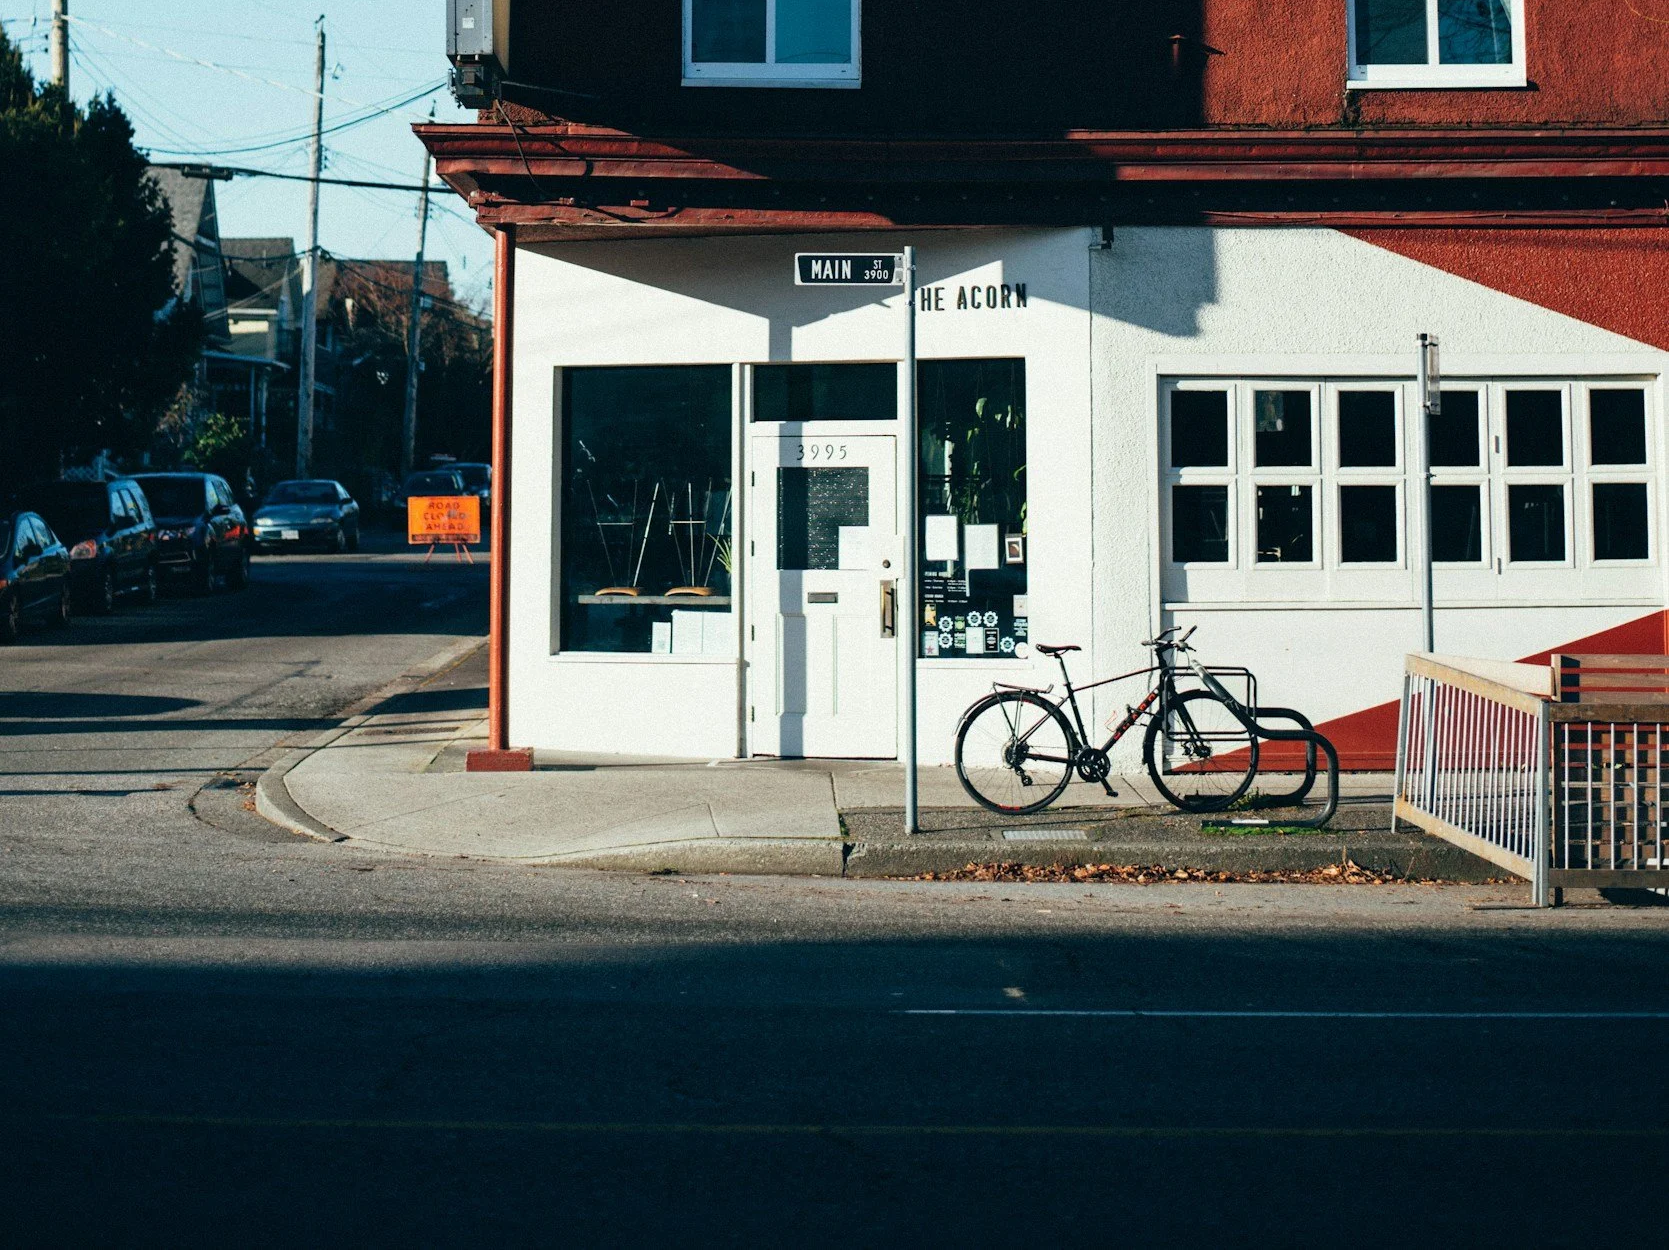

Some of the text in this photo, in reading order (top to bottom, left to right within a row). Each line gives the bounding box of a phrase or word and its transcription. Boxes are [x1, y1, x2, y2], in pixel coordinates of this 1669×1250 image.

[811, 259, 883, 279] MAIN ST
[864, 269, 889, 280] 3900
[917, 283, 1027, 312] HE ACORN
[796, 444, 847, 461] 3995
[428, 501, 460, 510] ROAD
[423, 512, 467, 520] CLOD
[426, 523, 464, 531] AHEAD
